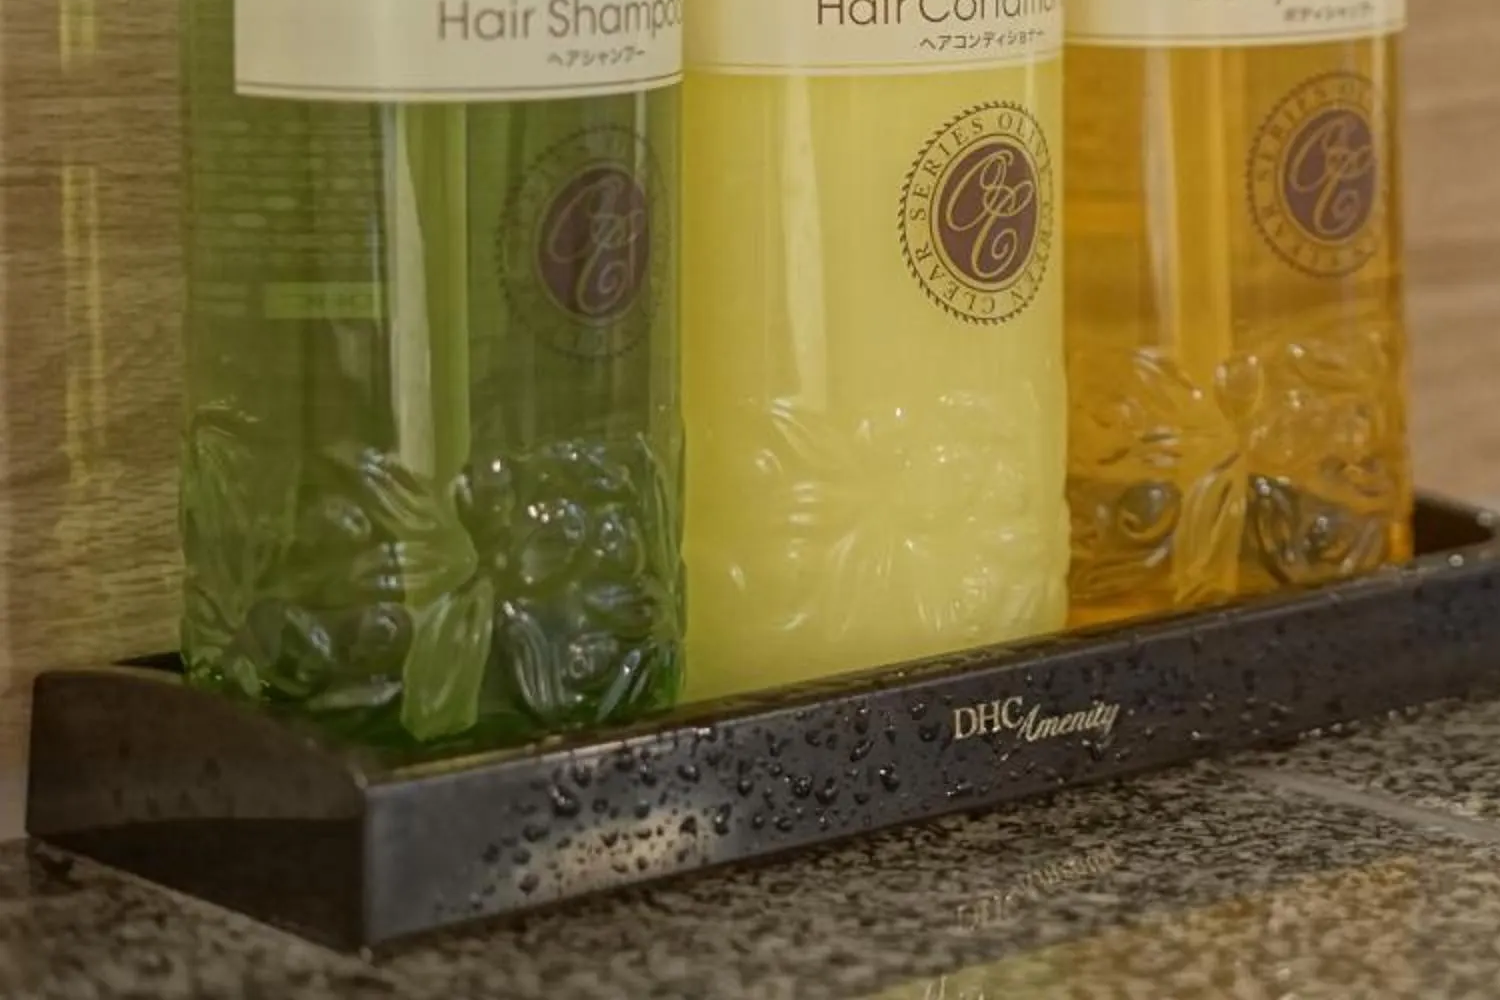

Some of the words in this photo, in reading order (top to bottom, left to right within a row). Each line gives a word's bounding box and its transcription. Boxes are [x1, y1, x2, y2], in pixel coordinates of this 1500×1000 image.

[909, 116, 984, 222] SERIES
[953, 695, 1024, 740] DHC
[1016, 701, 1121, 750] Amenity
